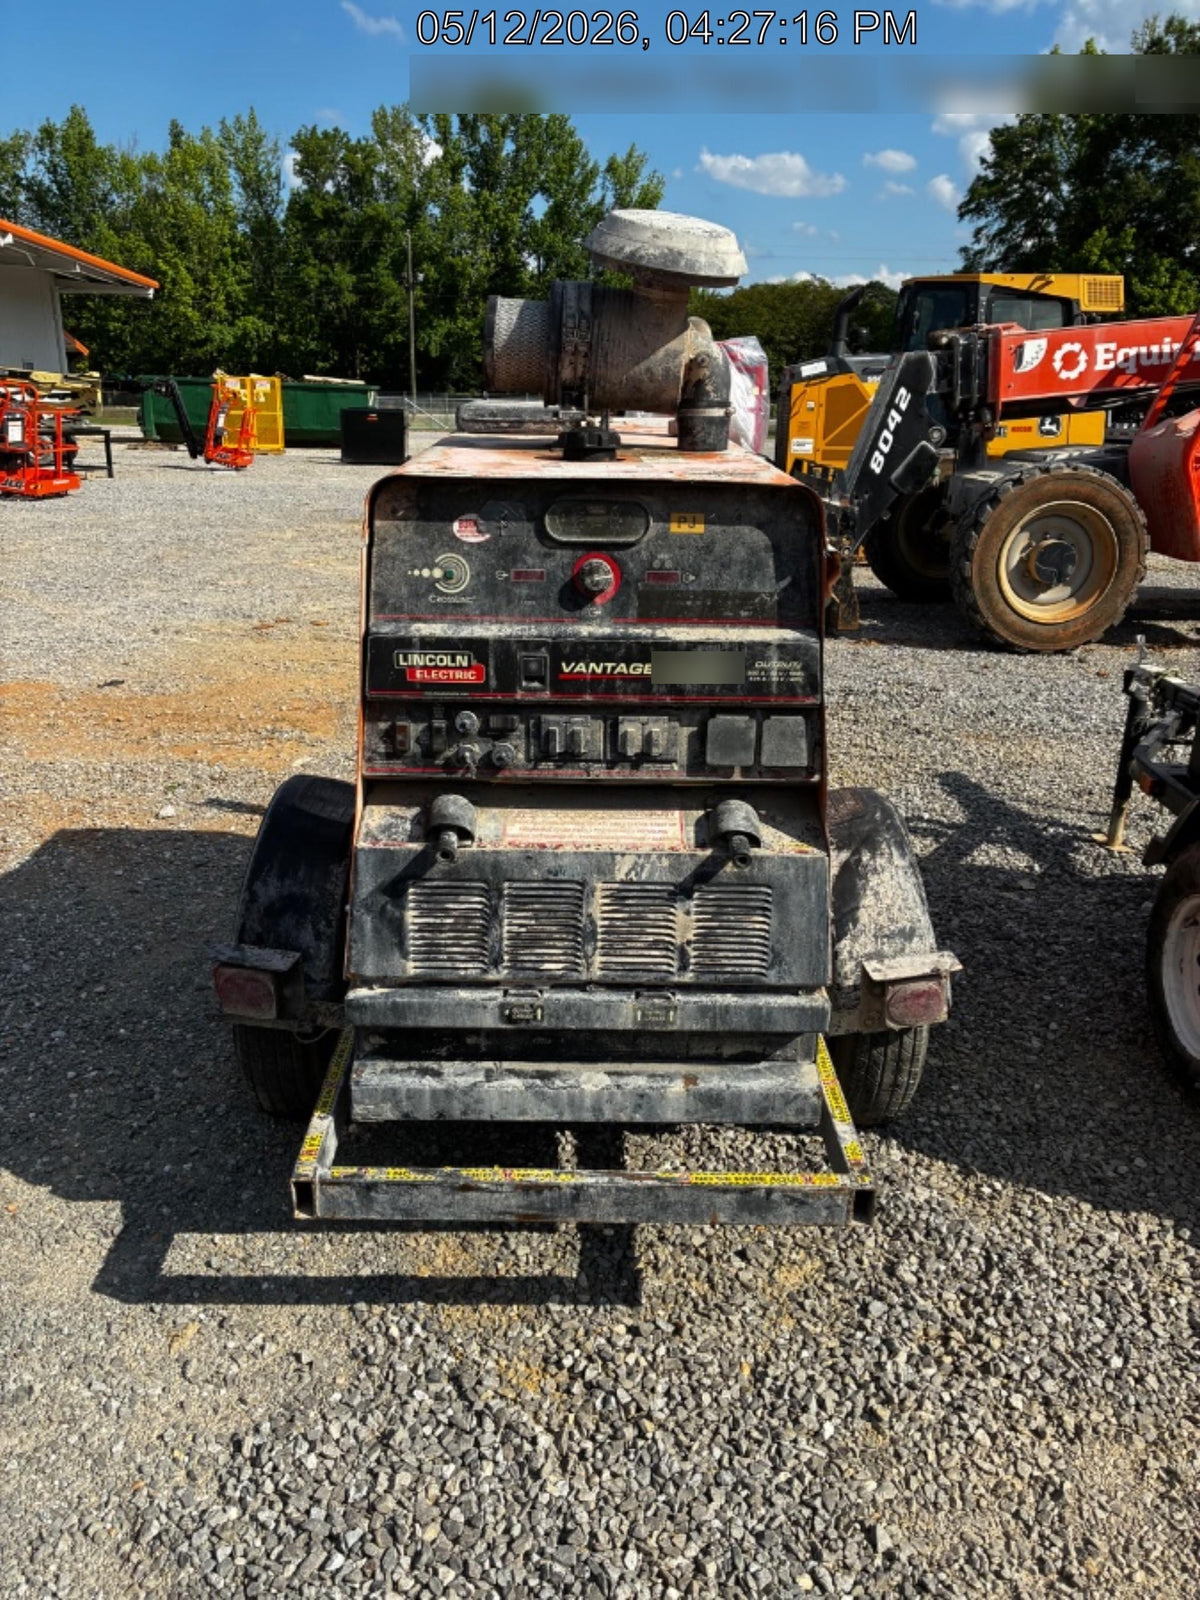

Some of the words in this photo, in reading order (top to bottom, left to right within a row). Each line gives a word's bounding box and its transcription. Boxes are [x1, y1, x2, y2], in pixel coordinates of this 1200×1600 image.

[870, 386, 912, 475] 8042
[677, 515, 696, 528] PJ
[399, 653, 468, 667] LINCOLN
[415, 669, 477, 680] ELECTRIC
